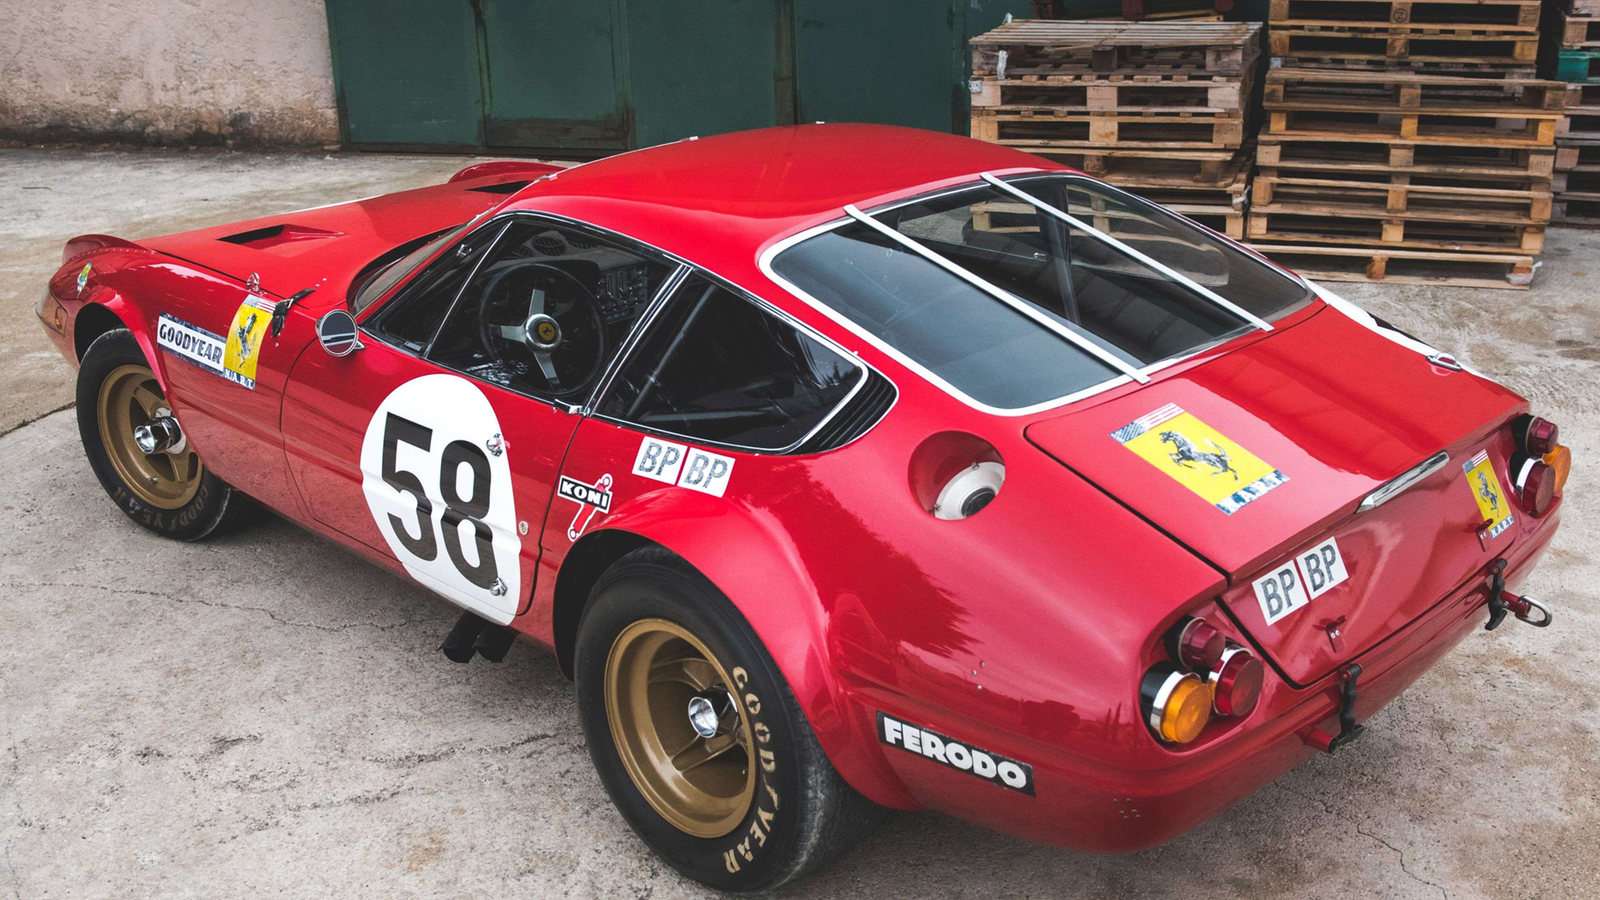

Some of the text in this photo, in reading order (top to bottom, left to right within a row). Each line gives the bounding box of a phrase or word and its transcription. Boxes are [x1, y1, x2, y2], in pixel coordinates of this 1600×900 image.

[160, 323, 223, 364] GOODYEAR
[561, 480, 609, 507] KONI
[638, 441, 728, 488] BP BP
[382, 411, 499, 590] 58
[1260, 544, 1336, 618] BP BP
[884, 717, 1027, 789] FERODO
